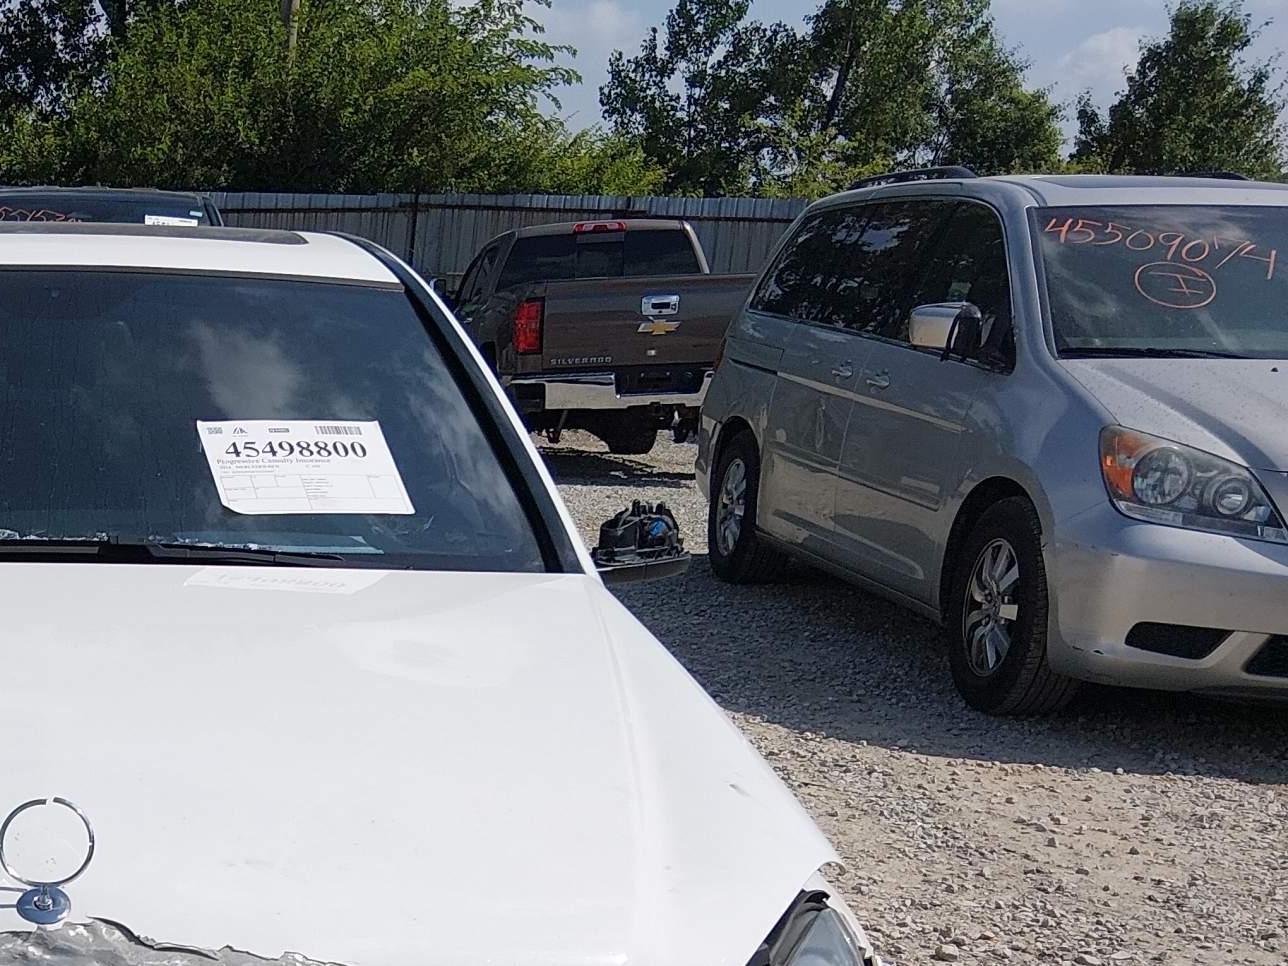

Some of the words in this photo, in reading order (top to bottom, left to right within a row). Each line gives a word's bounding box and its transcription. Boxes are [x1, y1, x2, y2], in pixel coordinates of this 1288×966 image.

[1045, 218, 1276, 280] 45509074
[551, 357, 612, 365] SILVERADO
[225, 440, 366, 458] 45498800
